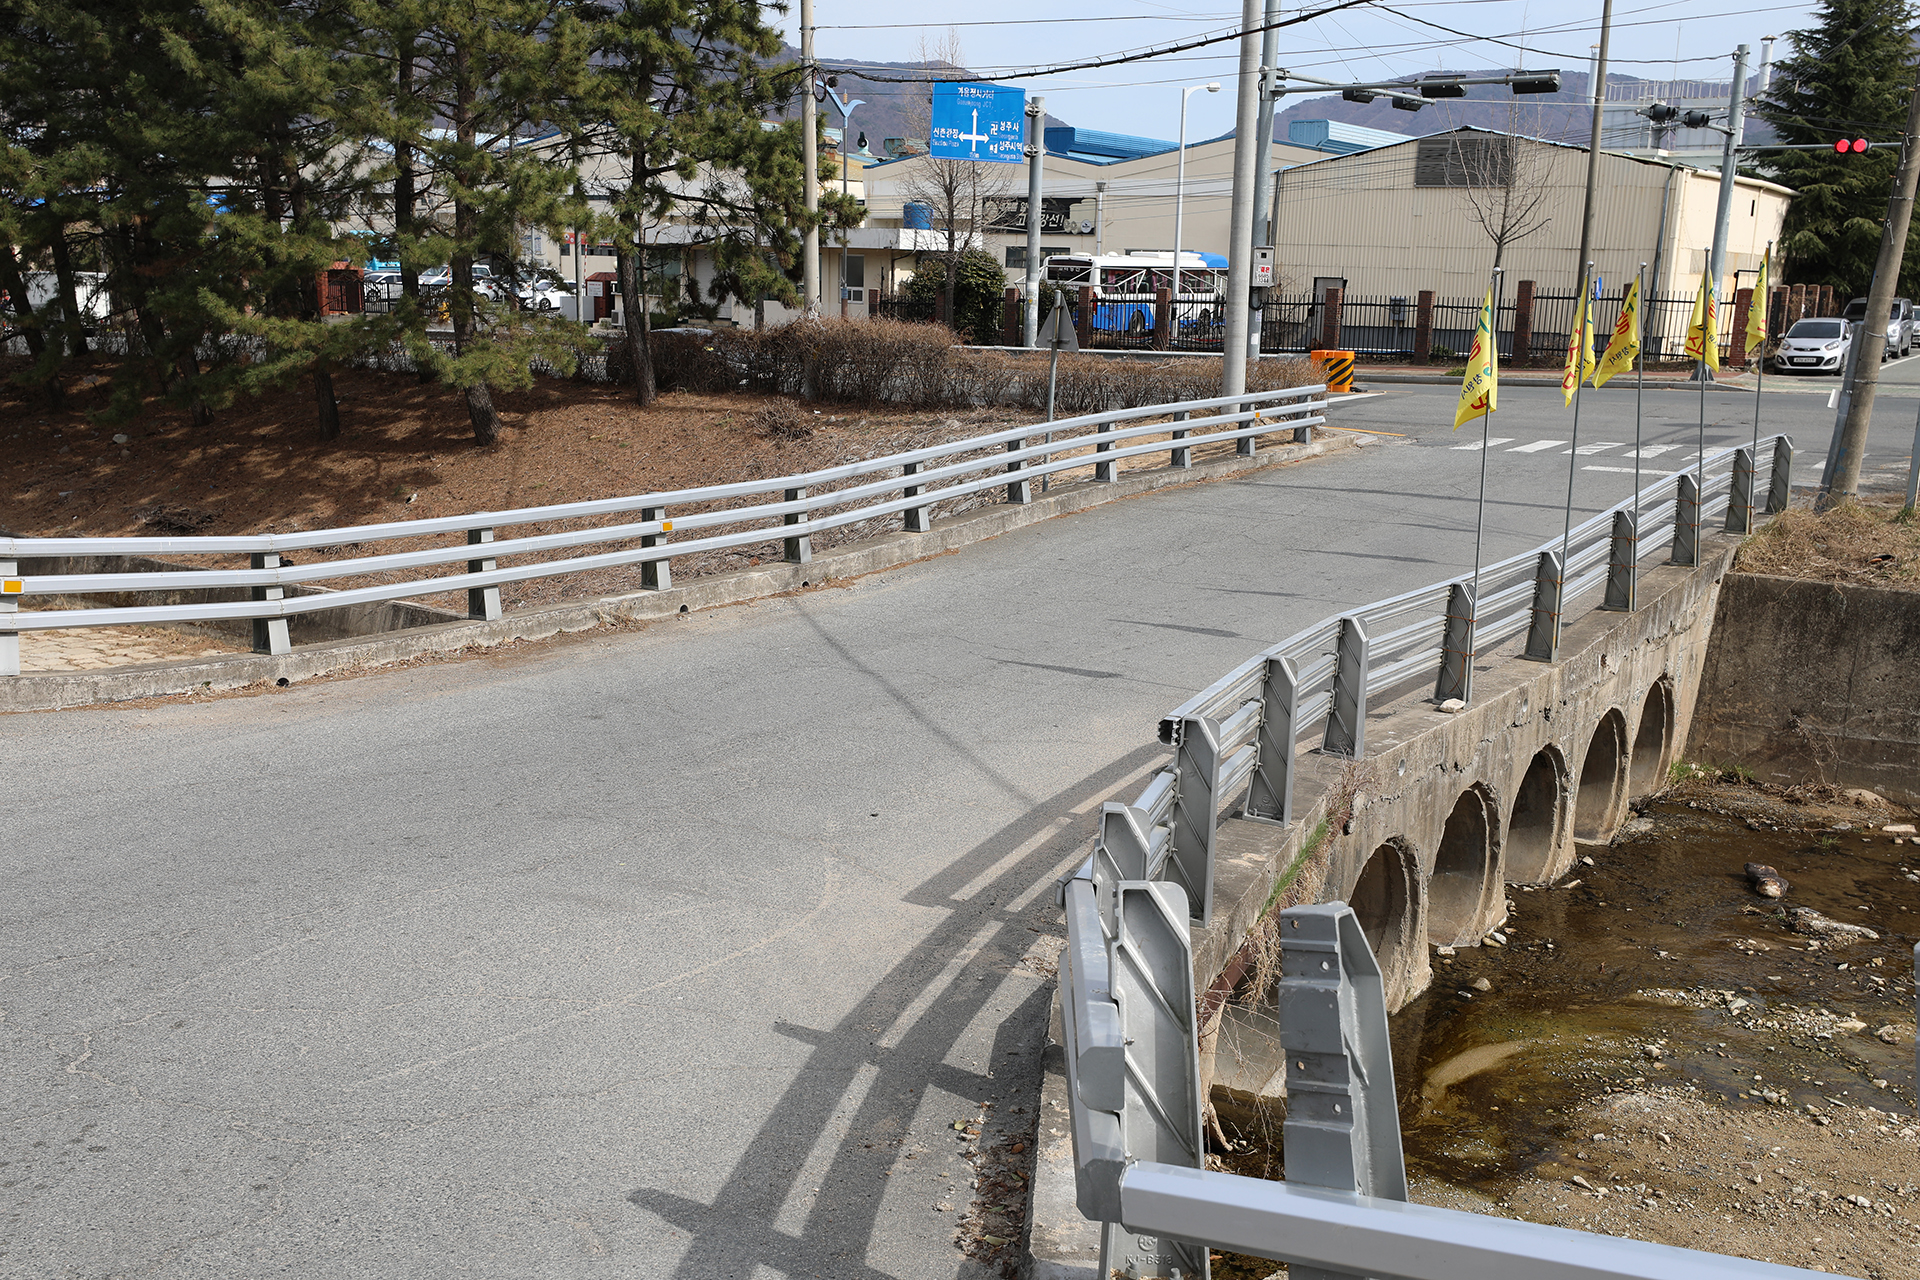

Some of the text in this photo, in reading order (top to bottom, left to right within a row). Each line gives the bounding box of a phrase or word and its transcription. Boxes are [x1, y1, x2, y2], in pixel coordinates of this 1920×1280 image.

[1000, 121, 1019, 132] 성주사
[933, 127, 959, 139] 신촌광장
[999, 141, 1023, 152] 성주사역
